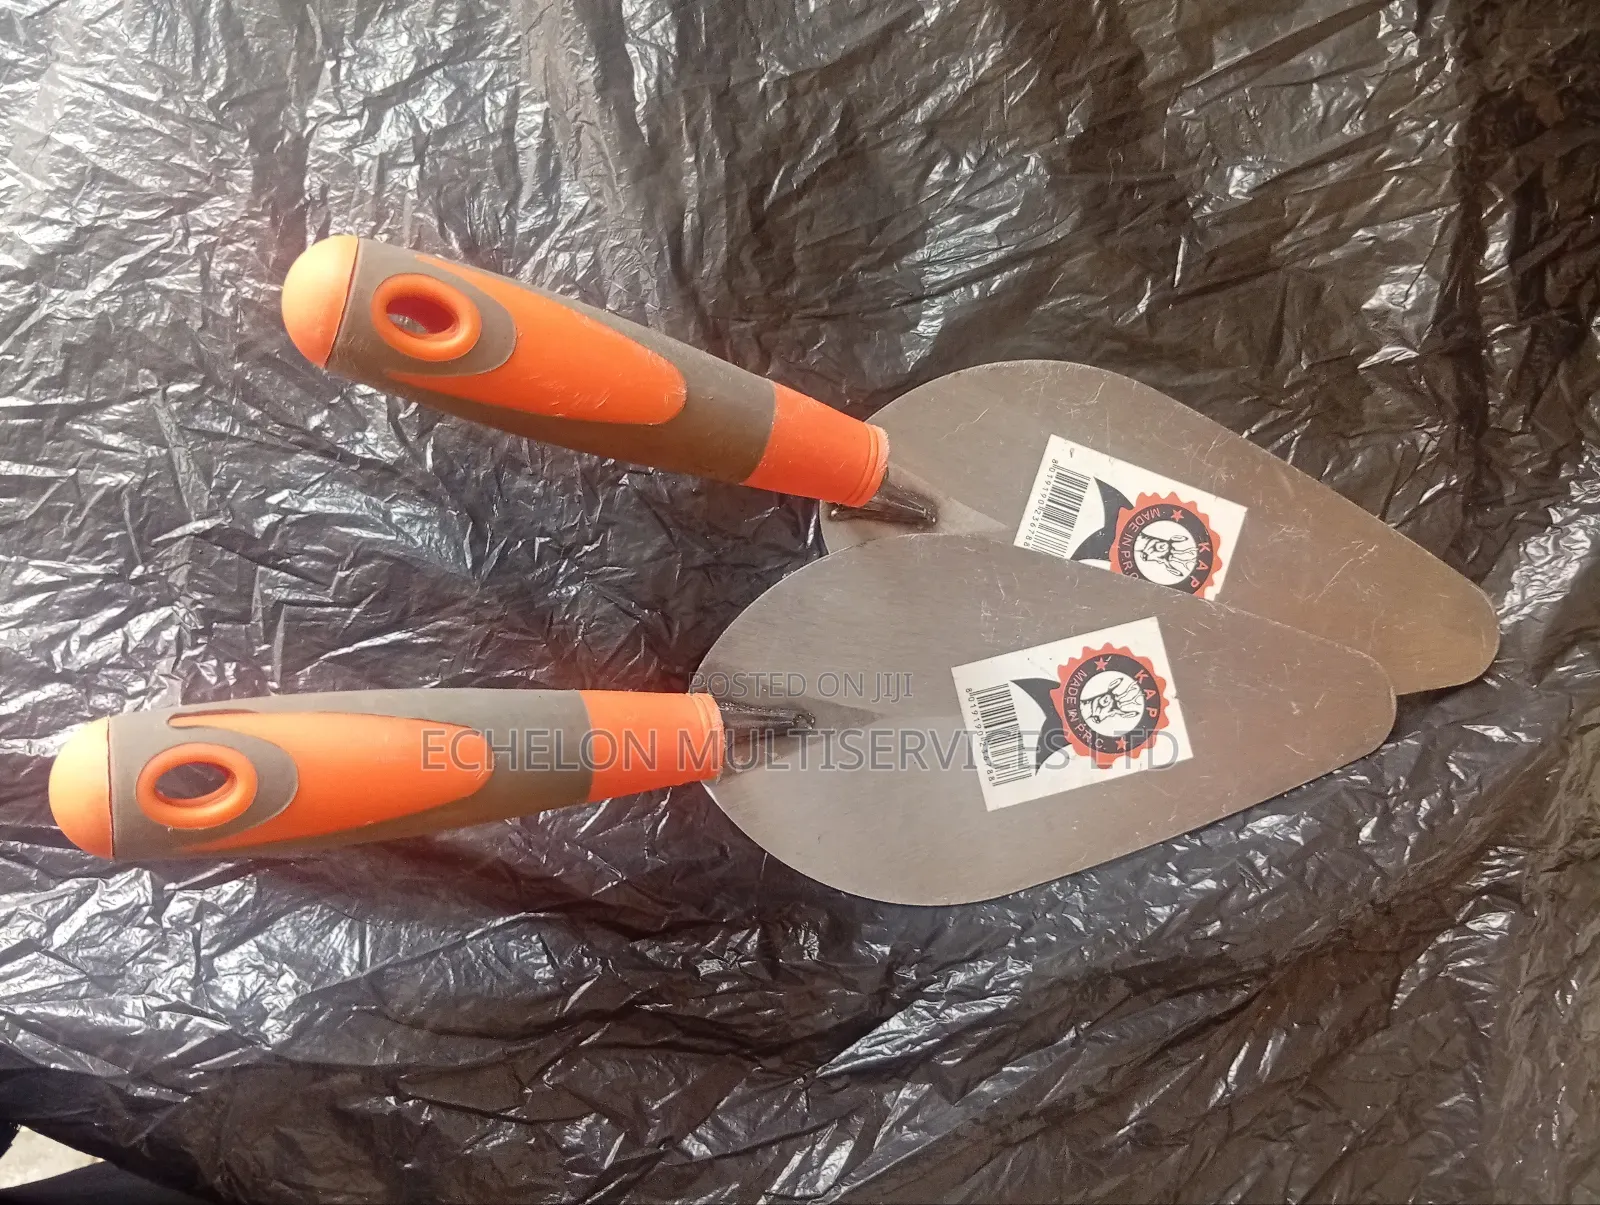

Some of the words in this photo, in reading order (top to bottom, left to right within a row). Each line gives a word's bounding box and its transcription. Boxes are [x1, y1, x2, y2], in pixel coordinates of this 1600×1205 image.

[1128, 507, 1160, 532] MADE
[1121, 532, 1134, 547] IN
[1190, 542, 1208, 589] KAP
[1064, 669, 1087, 706] MADE
[1134, 669, 1156, 718] KAP
